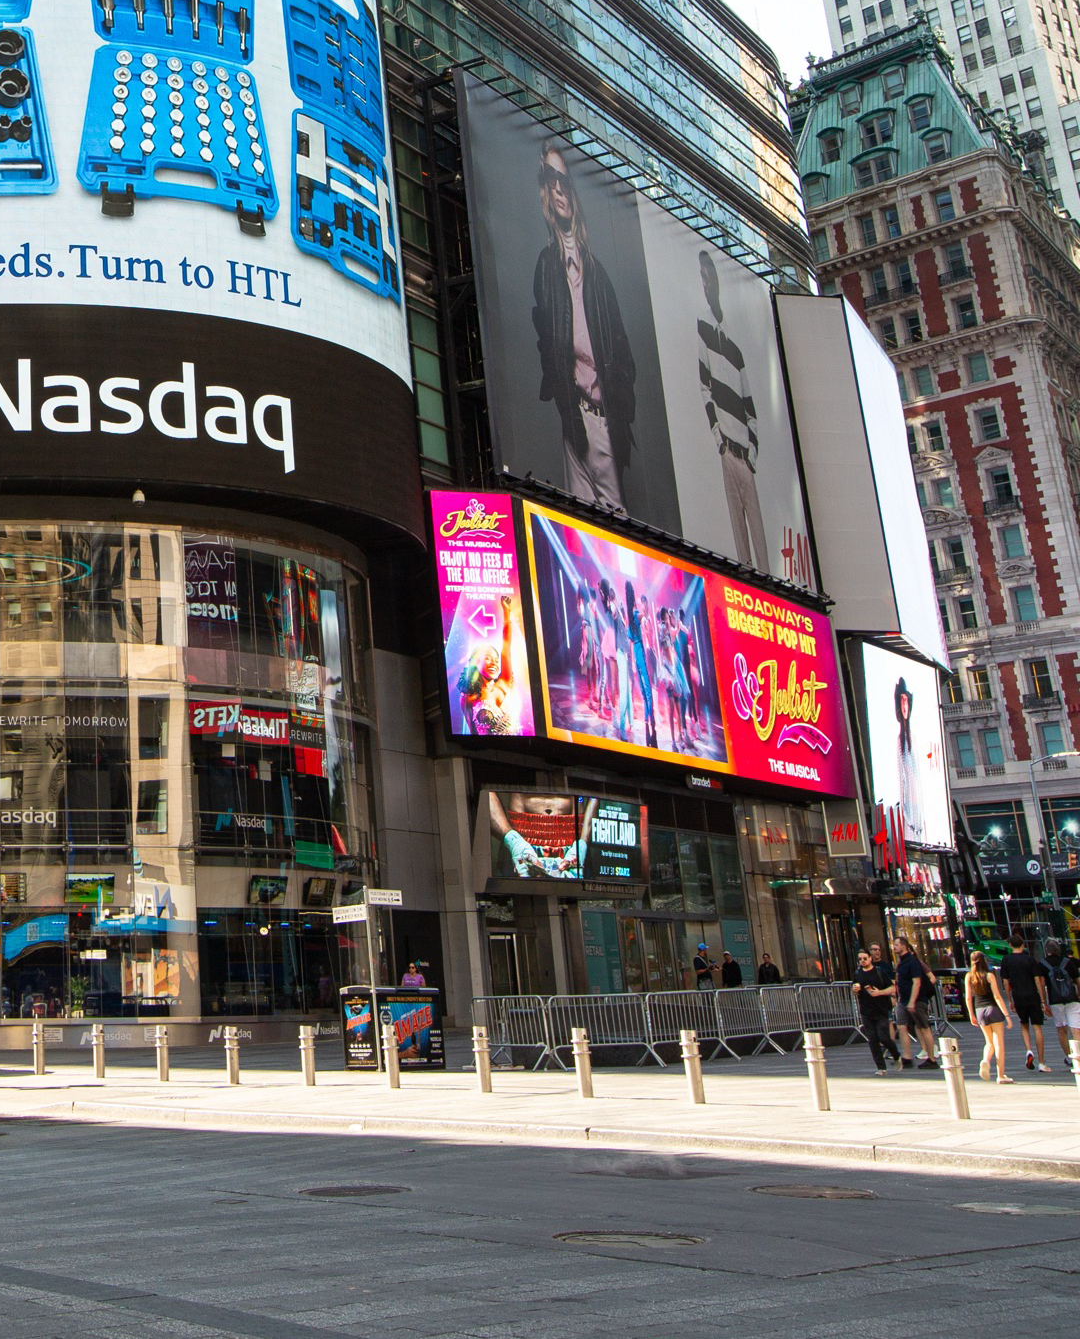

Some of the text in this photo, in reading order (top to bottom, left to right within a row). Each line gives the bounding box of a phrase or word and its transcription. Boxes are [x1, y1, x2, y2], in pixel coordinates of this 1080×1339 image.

[179, 256, 216, 288] to
[227, 260, 303, 309] HTL
[439, 509, 508, 537] Juliet
[447, 539, 503, 549] THE MUSICAL
[439, 550, 513, 569] ENJOY NO FEES AT
[780, 525, 812, 591] H&M
[446, 567, 511, 585] THE BOX OFFICE
[723, 586, 814, 633] BROADWAY'S
[726, 606, 817, 657] BIGGEST POP HIT
[753, 660, 828, 742] Juliet
[55, 715, 128, 727] TOMORROW
[237, 721, 275, 739] Nasdaq
[291, 729, 323, 744] REWRITE
[768, 758, 820, 782] THE MUSICAL
[591, 818, 636, 847] FIGHTLAND
[831, 822, 858, 842] H&M
[615, 866, 631, 877] STARZ
[584, 945, 605, 957] RETAIL
[320, 1025, 340, 1035] Nasdaq
[394, 1005, 433, 1044] AMAZE
[103, 1030, 132, 1043] asdaq
